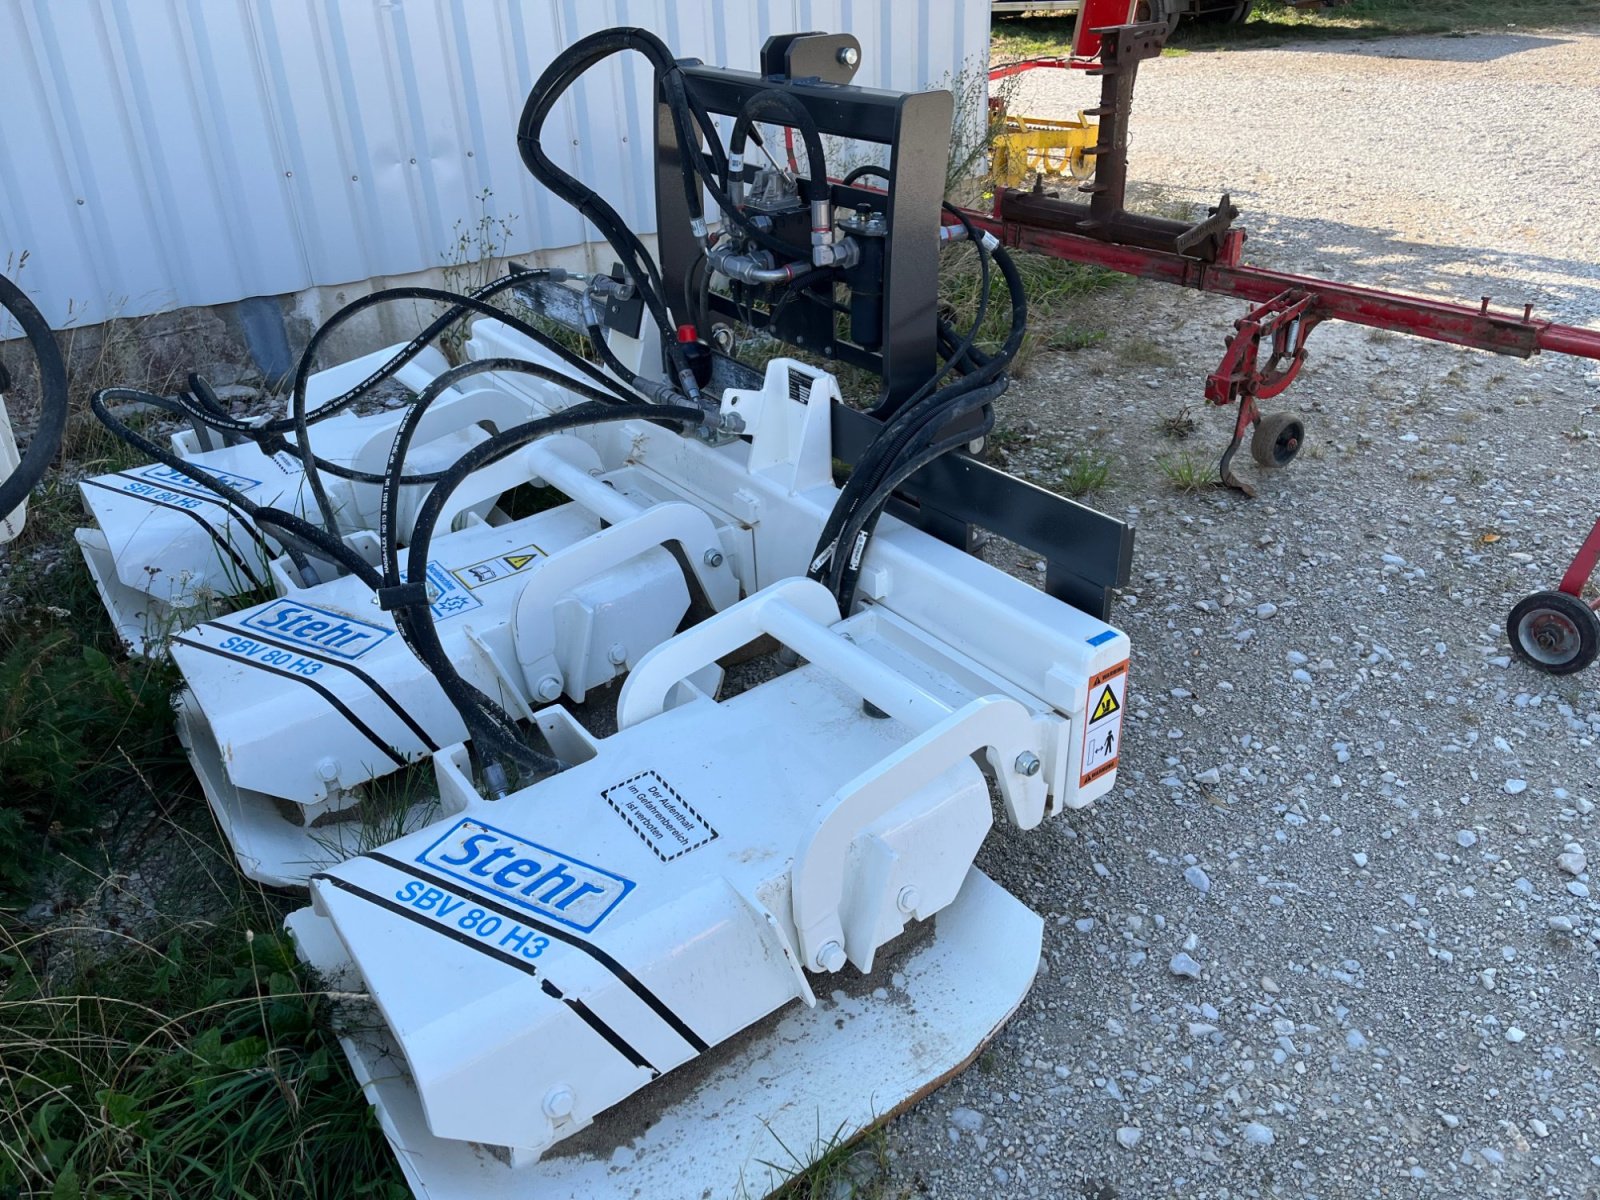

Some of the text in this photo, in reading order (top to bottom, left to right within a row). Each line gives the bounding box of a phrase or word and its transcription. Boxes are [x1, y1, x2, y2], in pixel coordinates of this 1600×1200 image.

[123, 482, 203, 509] SBV 80 H3
[258, 605, 371, 649] Stehr
[219, 635, 324, 676] SBV 80 H3
[625, 801, 664, 840] ist verboten
[627, 784, 689, 846] im Gefahrenbereich
[648, 785, 695, 831] Der Aufenthalt
[440, 832, 605, 911] Stehr
[395, 880, 550, 959] SBV 80 H3
